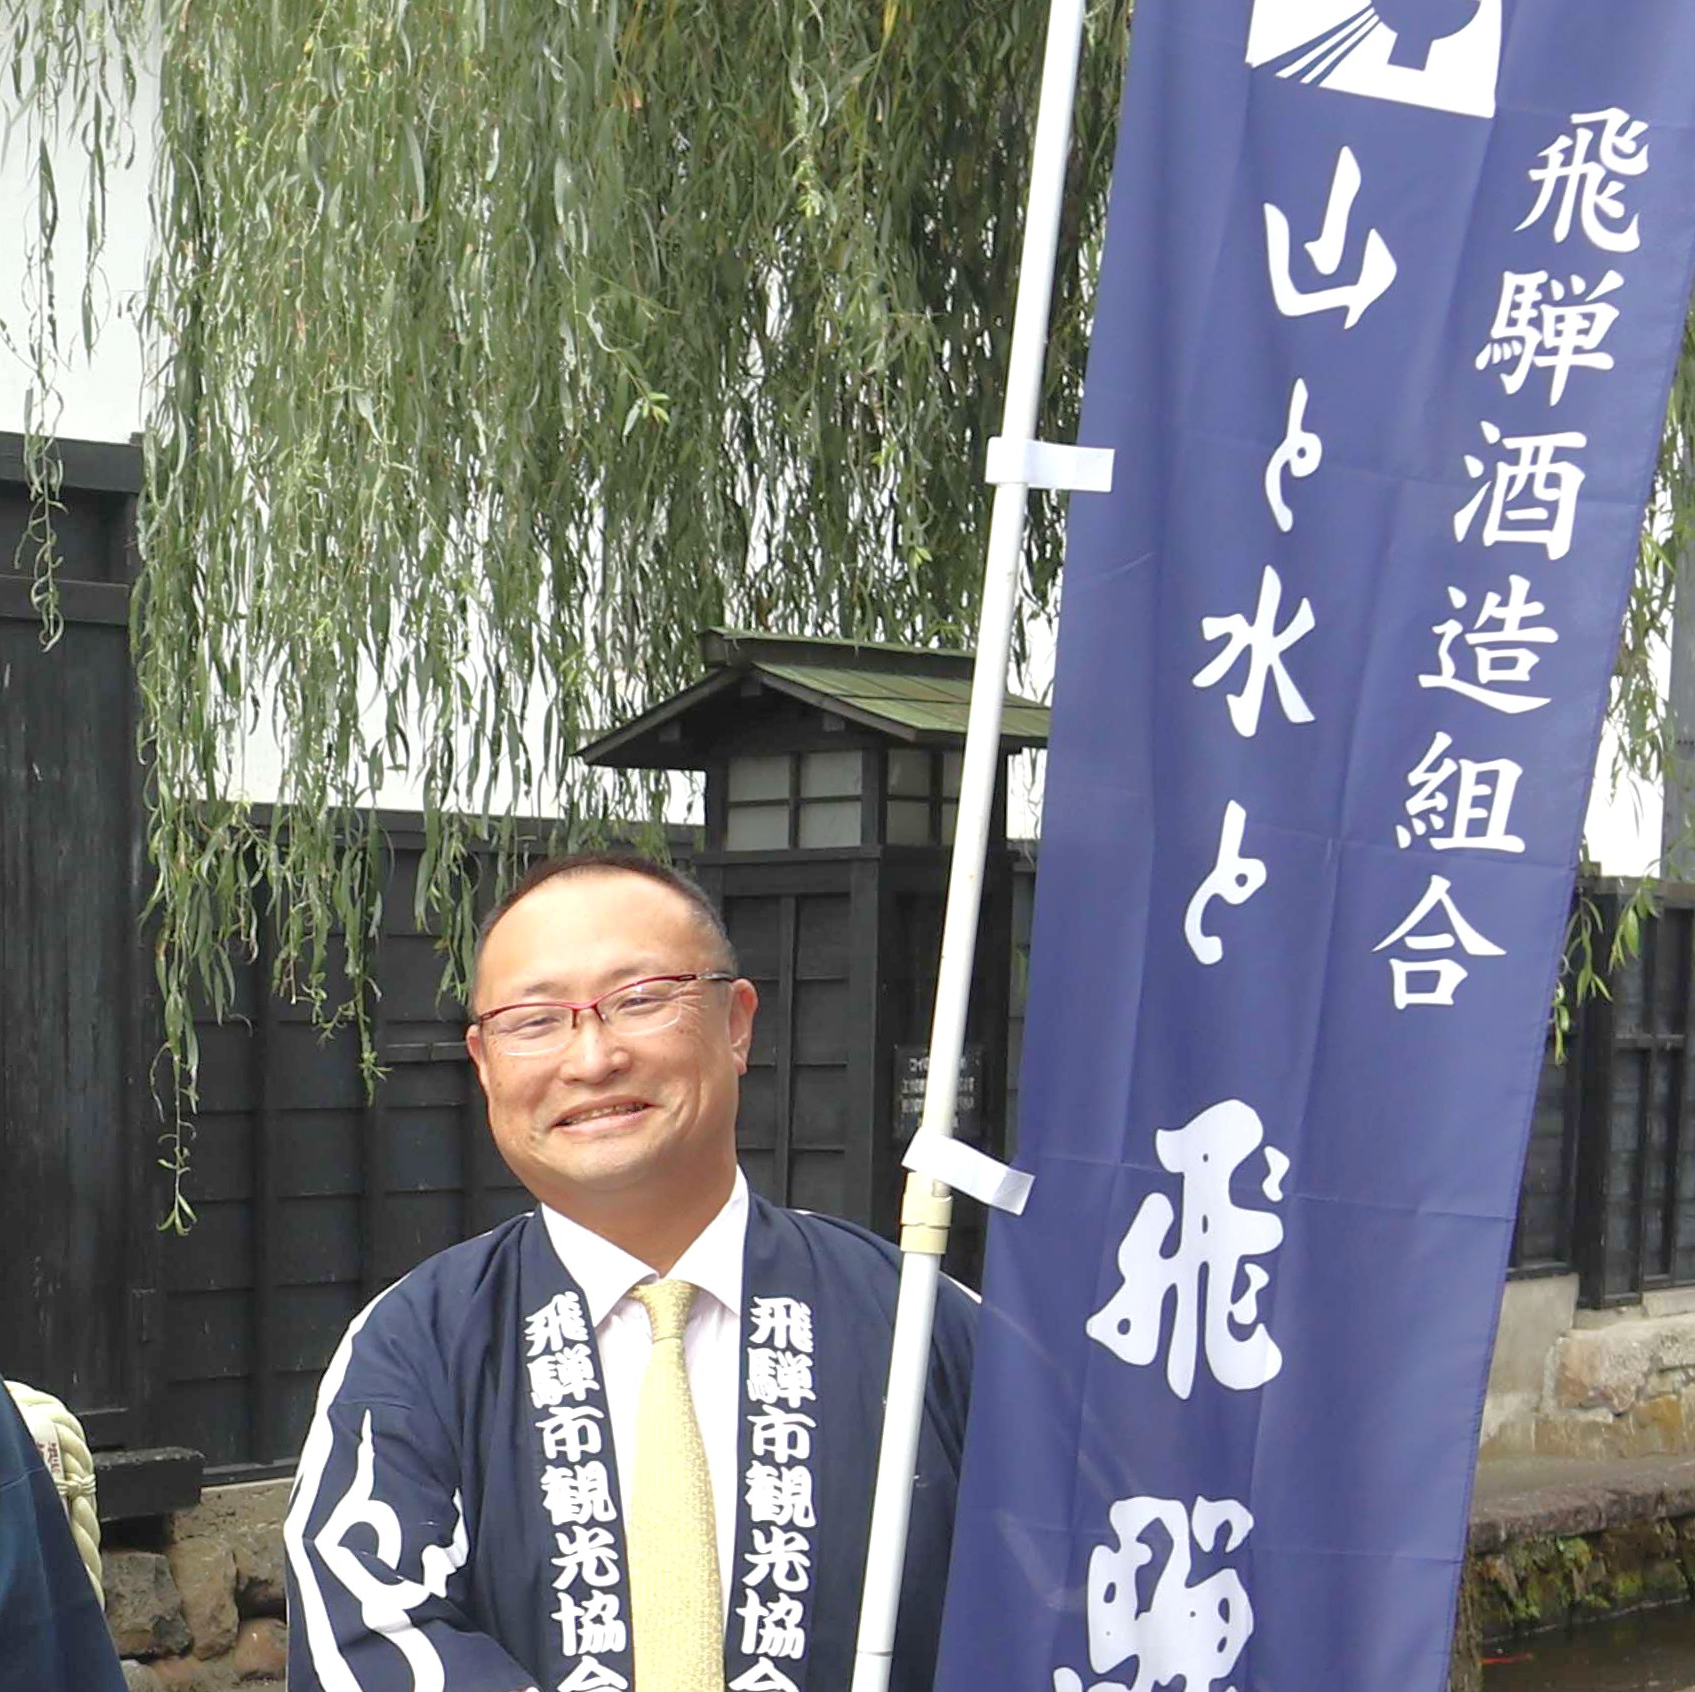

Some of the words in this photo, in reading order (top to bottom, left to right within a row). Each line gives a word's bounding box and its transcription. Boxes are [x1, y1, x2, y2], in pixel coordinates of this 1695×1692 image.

[1372, 107, 1650, 1007] 飛騨酒造組合
